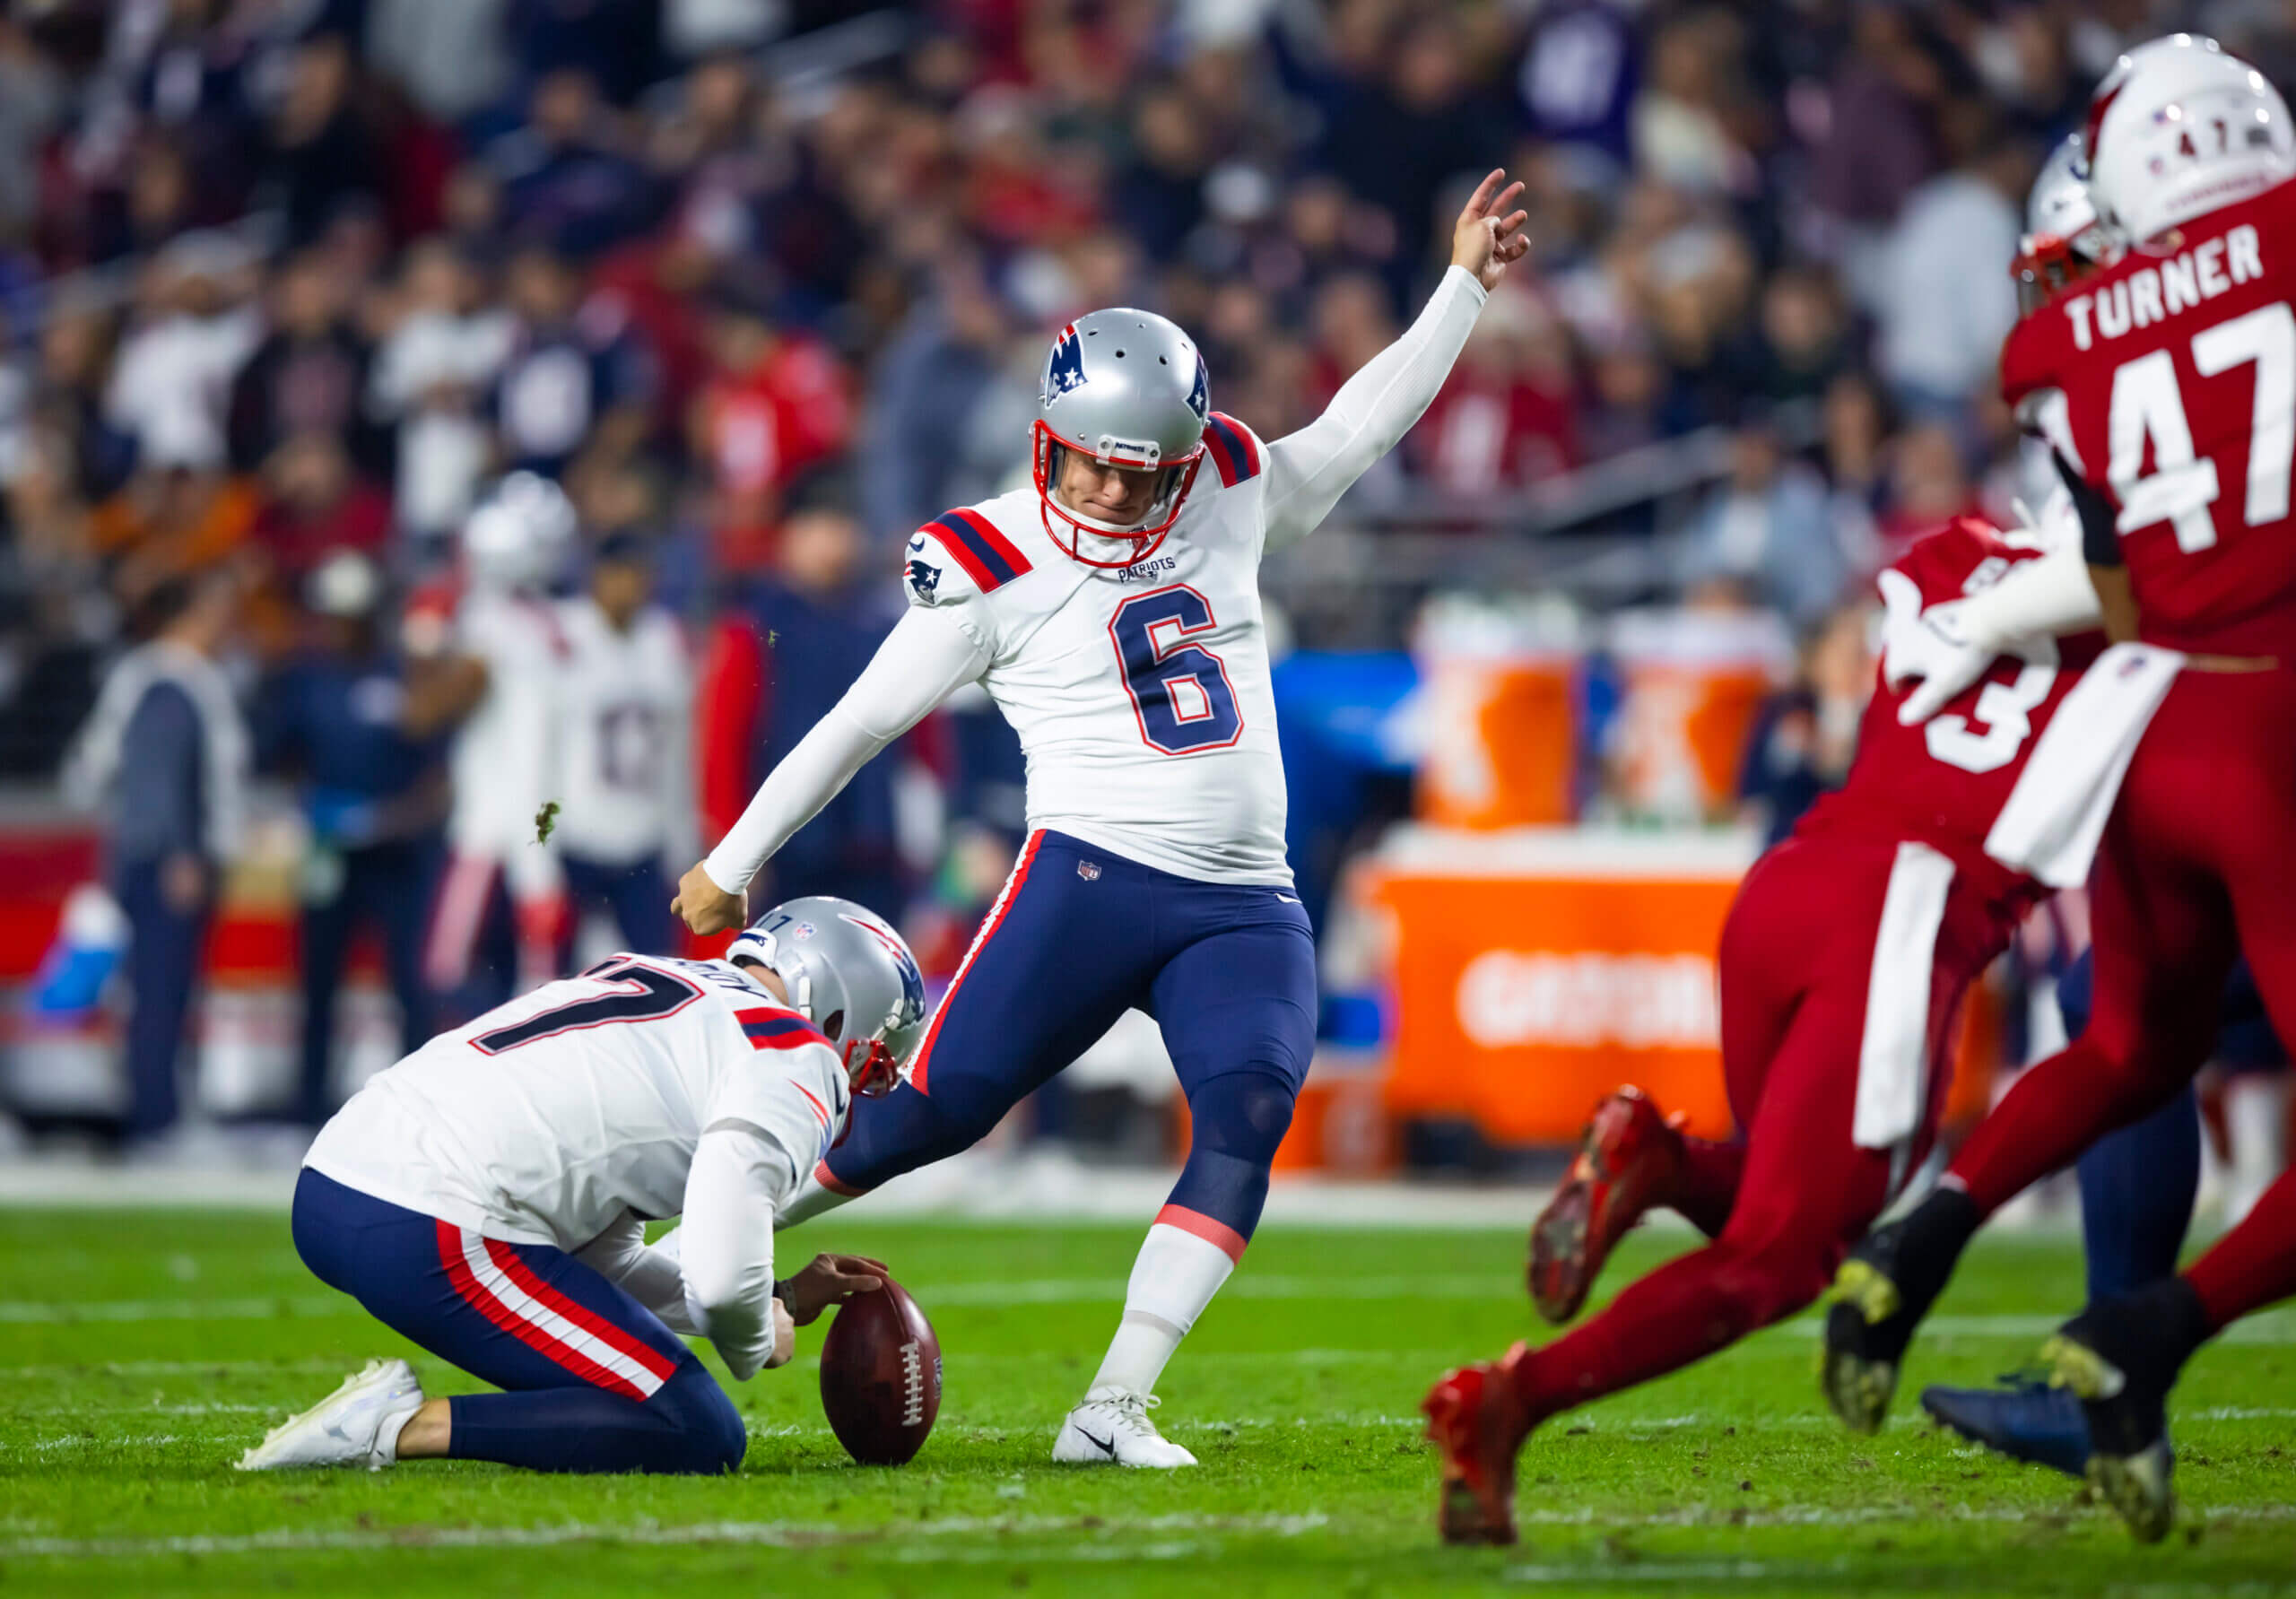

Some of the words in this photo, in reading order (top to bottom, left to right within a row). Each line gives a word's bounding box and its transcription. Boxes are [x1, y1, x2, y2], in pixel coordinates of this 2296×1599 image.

[2178, 117, 2228, 159] 47
[2065, 223, 2264, 352] TURNER
[2108, 300, 2296, 554] 47
[1118, 556, 1176, 584] PATRIOTS
[1107, 582, 1245, 756] 6
[1925, 628, 2060, 775] 3
[758, 913, 793, 933] 17
